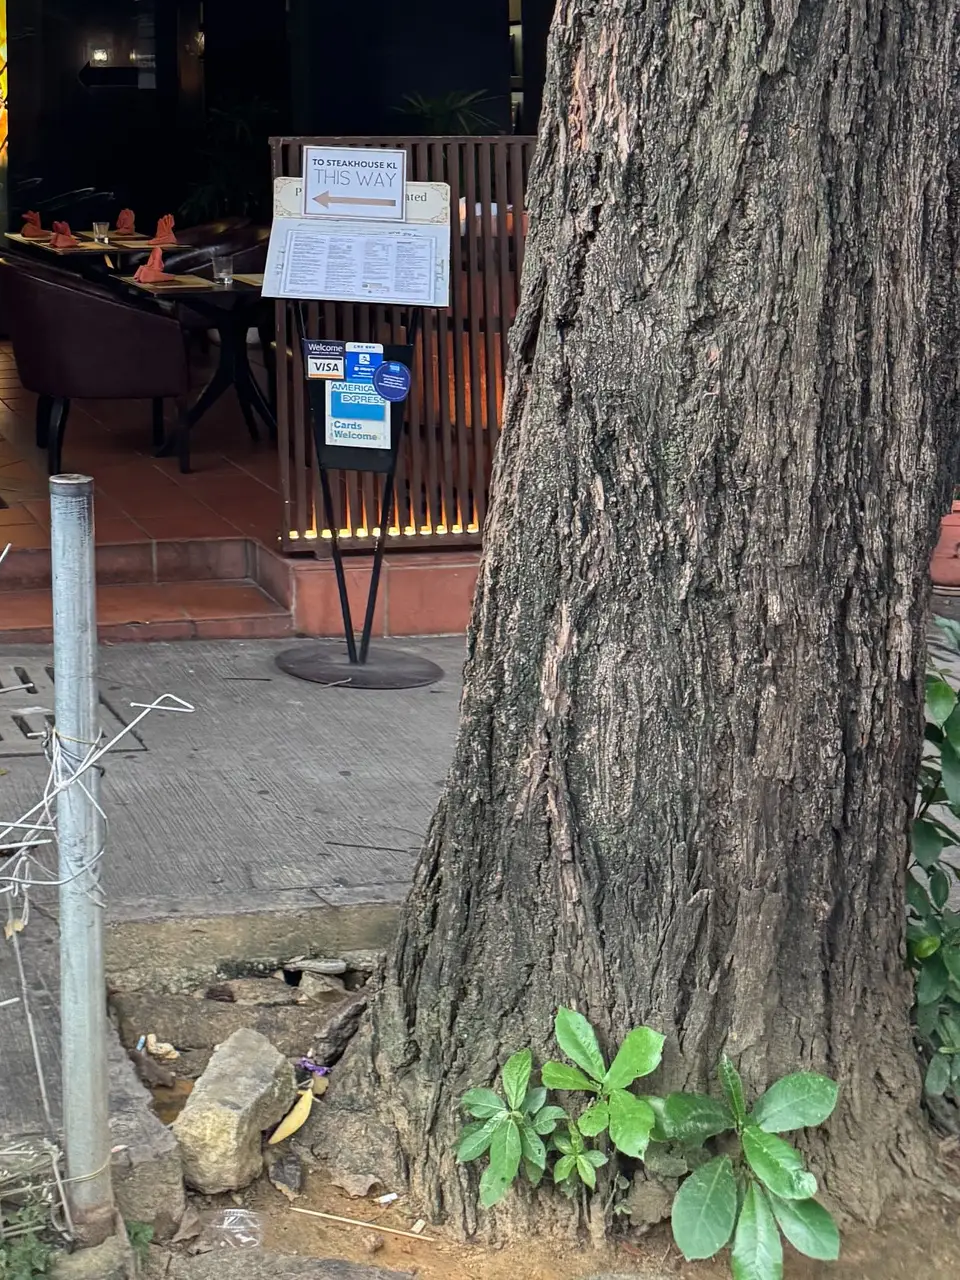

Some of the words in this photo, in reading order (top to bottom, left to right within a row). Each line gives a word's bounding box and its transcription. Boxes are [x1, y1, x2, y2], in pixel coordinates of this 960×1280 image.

[326, 160, 384, 168] STEAKHOUSE
[314, 169, 351, 185] THIS
[355, 170, 397, 187] WAY
[308, 343, 343, 352] Welcome
[313, 362, 339, 372] VISA
[331, 383, 375, 392] AMERICA
[342, 394, 386, 404] EXPRESS
[333, 420, 362, 430] Cards
[333, 430, 378, 441] Welcome
